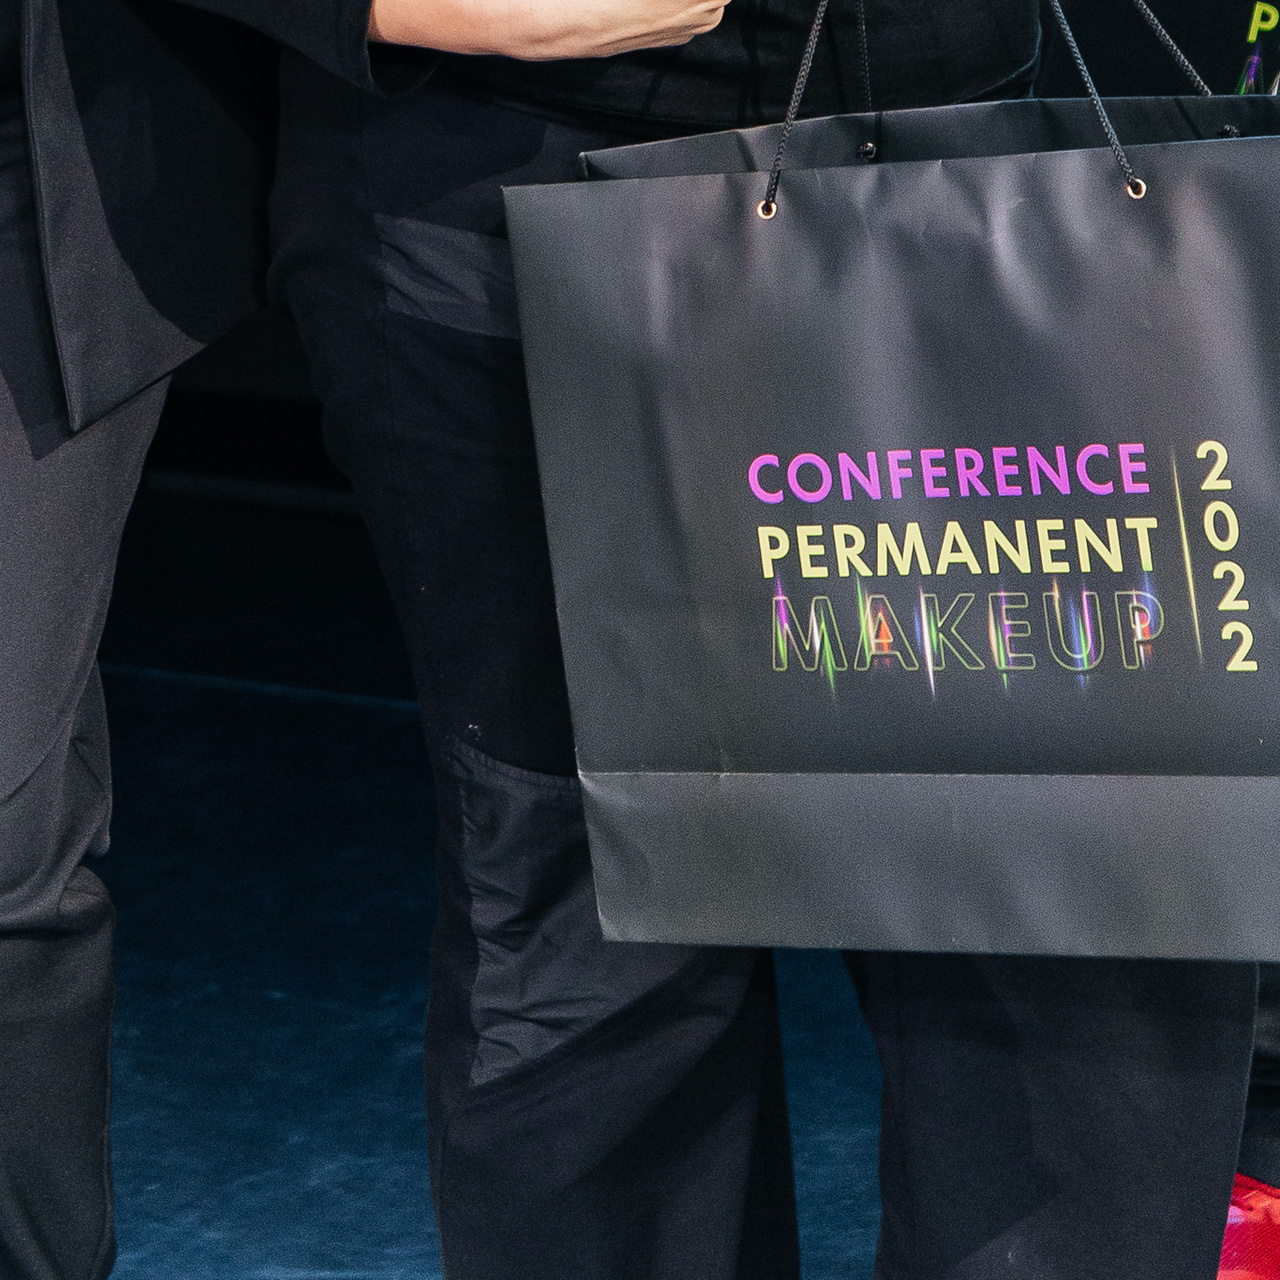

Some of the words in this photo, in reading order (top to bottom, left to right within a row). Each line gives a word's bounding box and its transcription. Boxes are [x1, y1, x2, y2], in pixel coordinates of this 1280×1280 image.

[748, 443, 1151, 504] CONFERENCE
[757, 517, 1159, 578] PERMANENT
[1195, 440, 1259, 673] 2022
[771, 590, 1166, 673] MAKEUP
